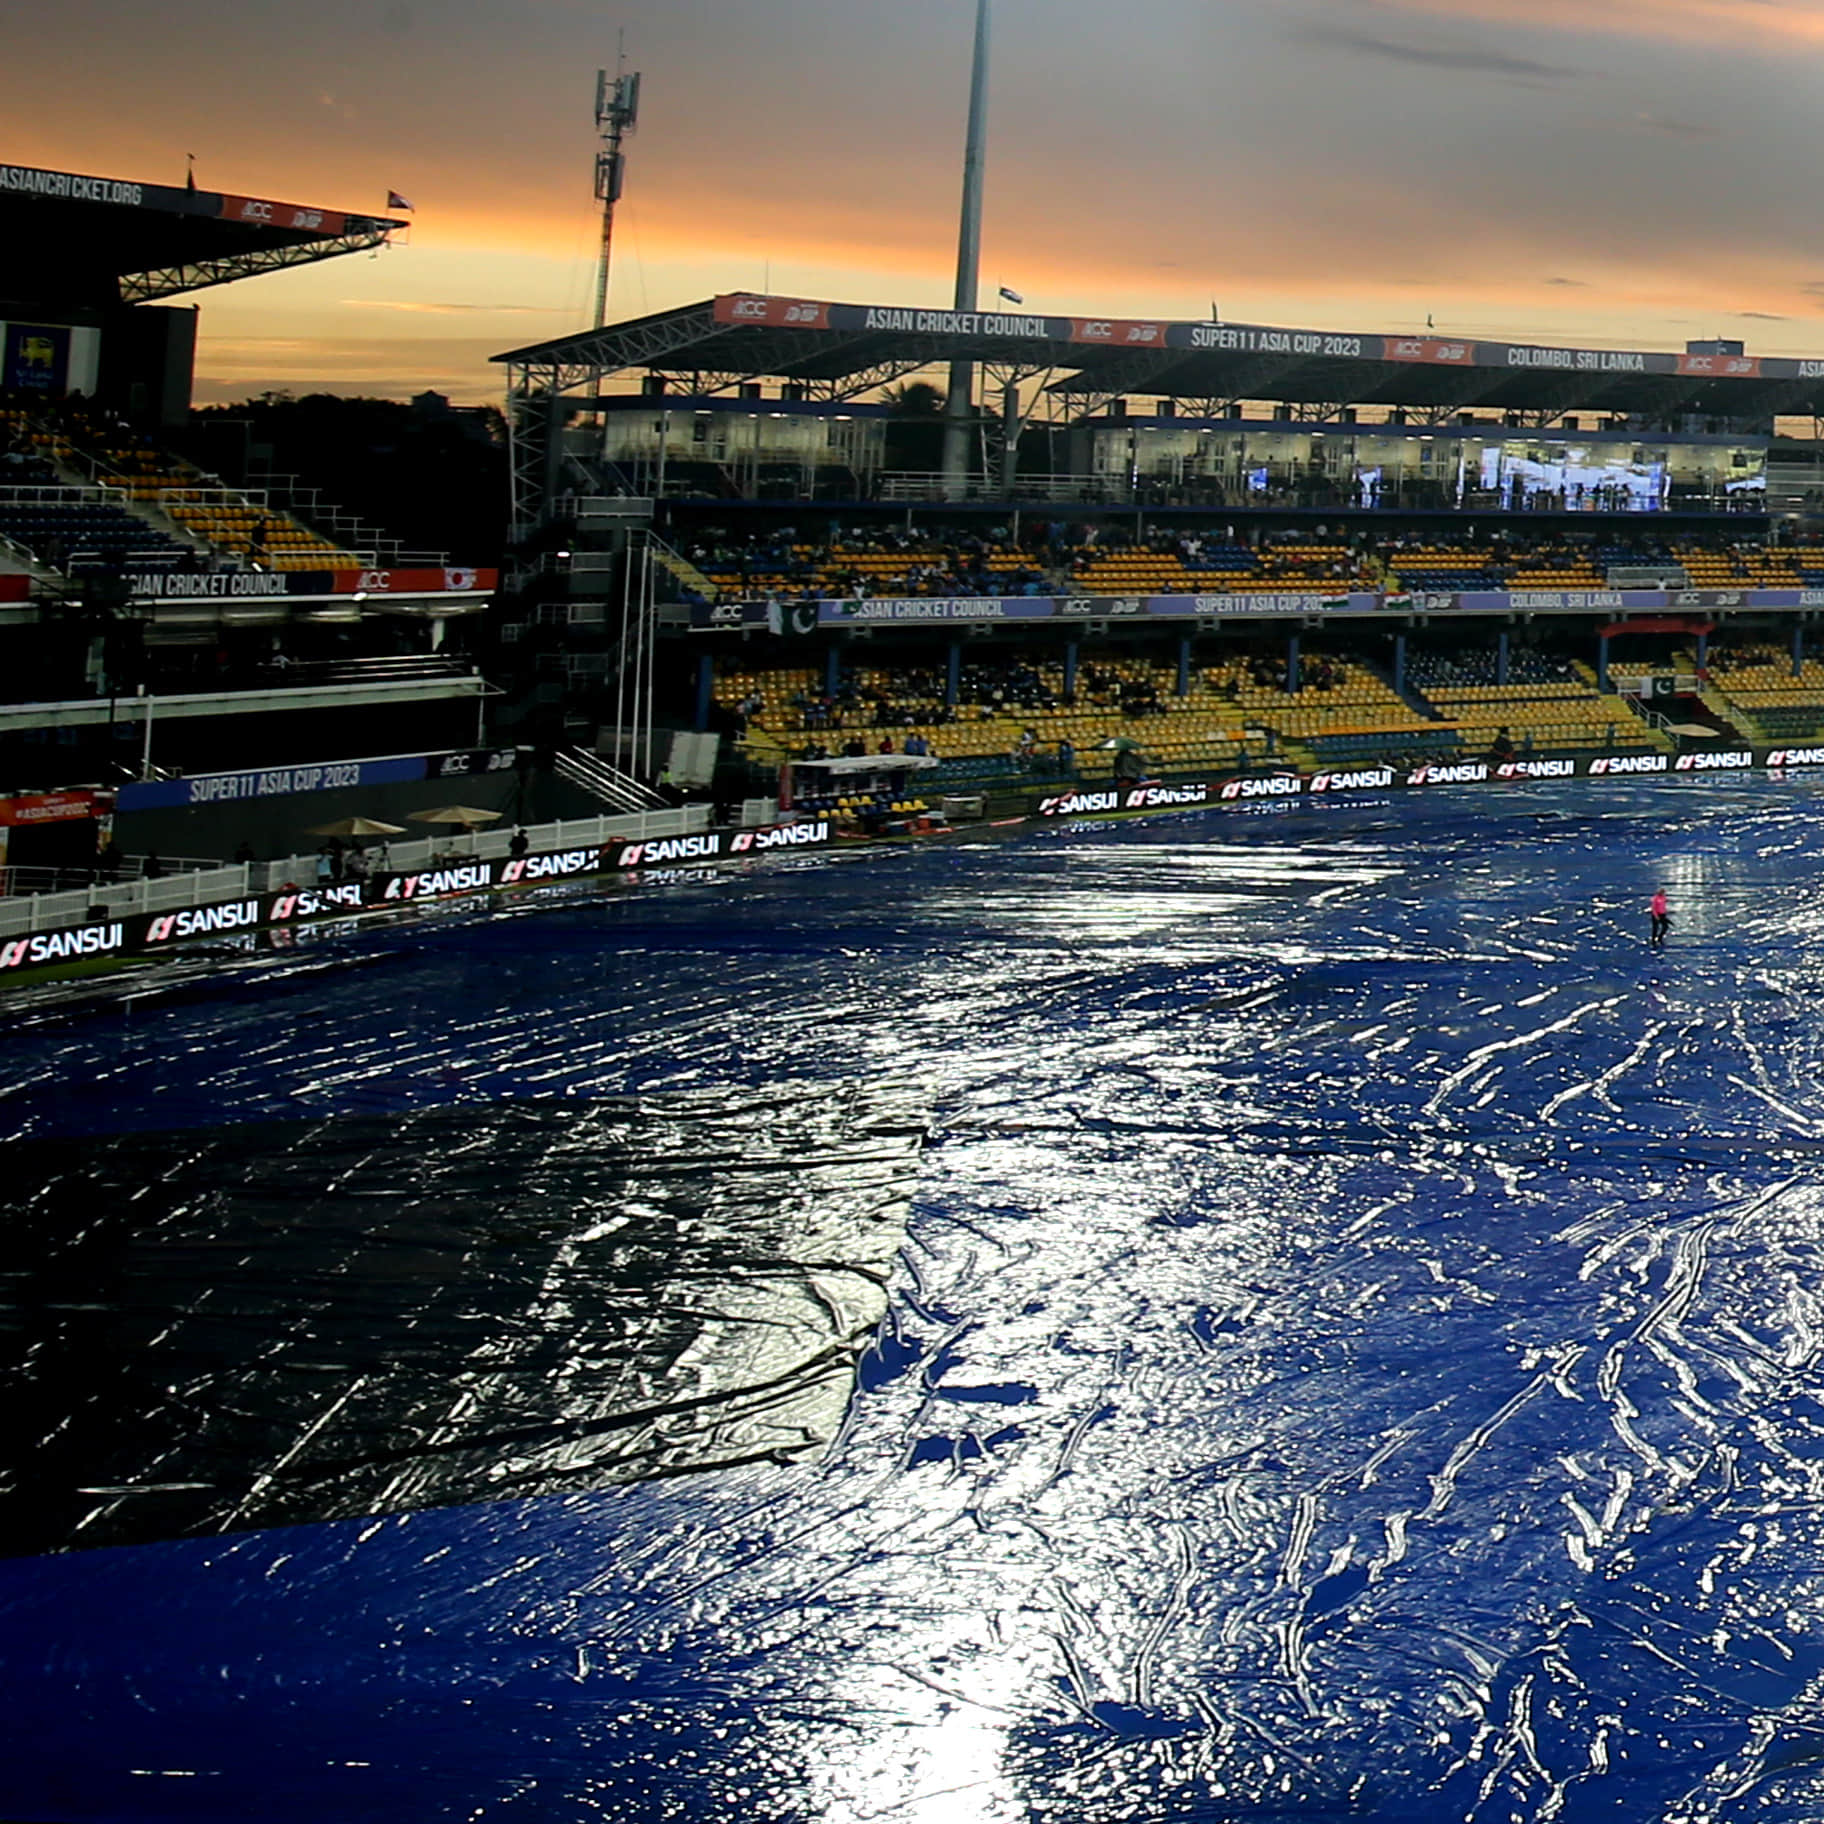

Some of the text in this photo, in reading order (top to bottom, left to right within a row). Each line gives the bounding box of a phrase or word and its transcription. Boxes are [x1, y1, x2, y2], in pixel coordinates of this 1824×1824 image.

[866, 308, 1048, 337] ASIAN CRICKET COUNCIL
[1191, 328, 1360, 356] SUPER11 ASIA CUP 2023
[1507, 349, 1644, 371] COLOMBO, SRI LANKA
[166, 575, 288, 594] CRICKET COUNCIL
[896, 598, 1004, 618] CRICKET COUNCIL
[1249, 595, 1276, 611] ASIA
[1279, 594, 1300, 610] CUP
[1568, 593, 1587, 609] SRI
[1590, 592, 1622, 608] LANKA
[1609, 757, 1666, 773] SANSUI
[1695, 753, 1751, 768] SANSUI
[190, 765, 359, 803] SUPER11 ASIA CUP 2023
[1332, 771, 1391, 789] SANSUI
[1428, 765, 1487, 783] SANSUI
[1241, 778, 1300, 798] SANSUI
[755, 822, 828, 849] SANSUI
[644, 835, 719, 862] SANSUI
[419, 864, 491, 895] SANSUI
[176, 901, 258, 935] SANSUI
[30, 924, 123, 961] SANSUI
